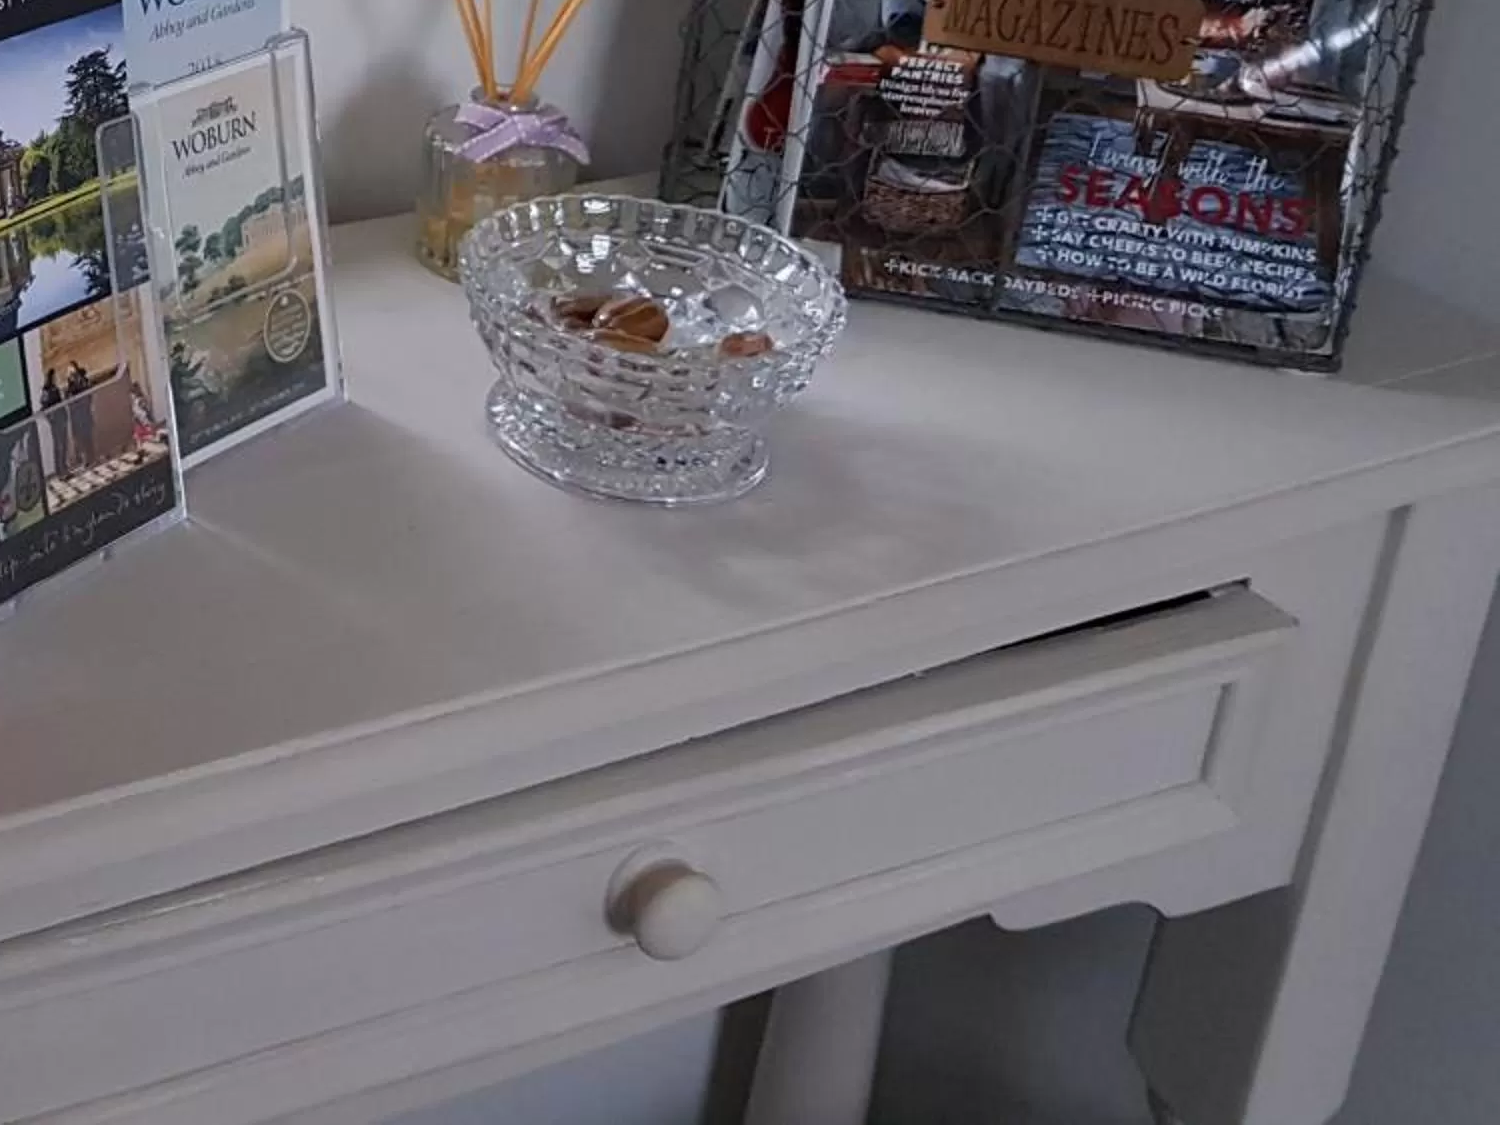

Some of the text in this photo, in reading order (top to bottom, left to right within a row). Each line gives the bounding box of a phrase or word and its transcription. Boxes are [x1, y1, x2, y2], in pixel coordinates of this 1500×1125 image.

[149, 17, 185, 43] Abbey
[186, 6, 209, 29] and
[171, 110, 257, 161] WOBURN
[1244, 155, 1285, 193] the
[1057, 163, 1317, 240] SEASONS
[1056, 249, 1104, 268] HOW
